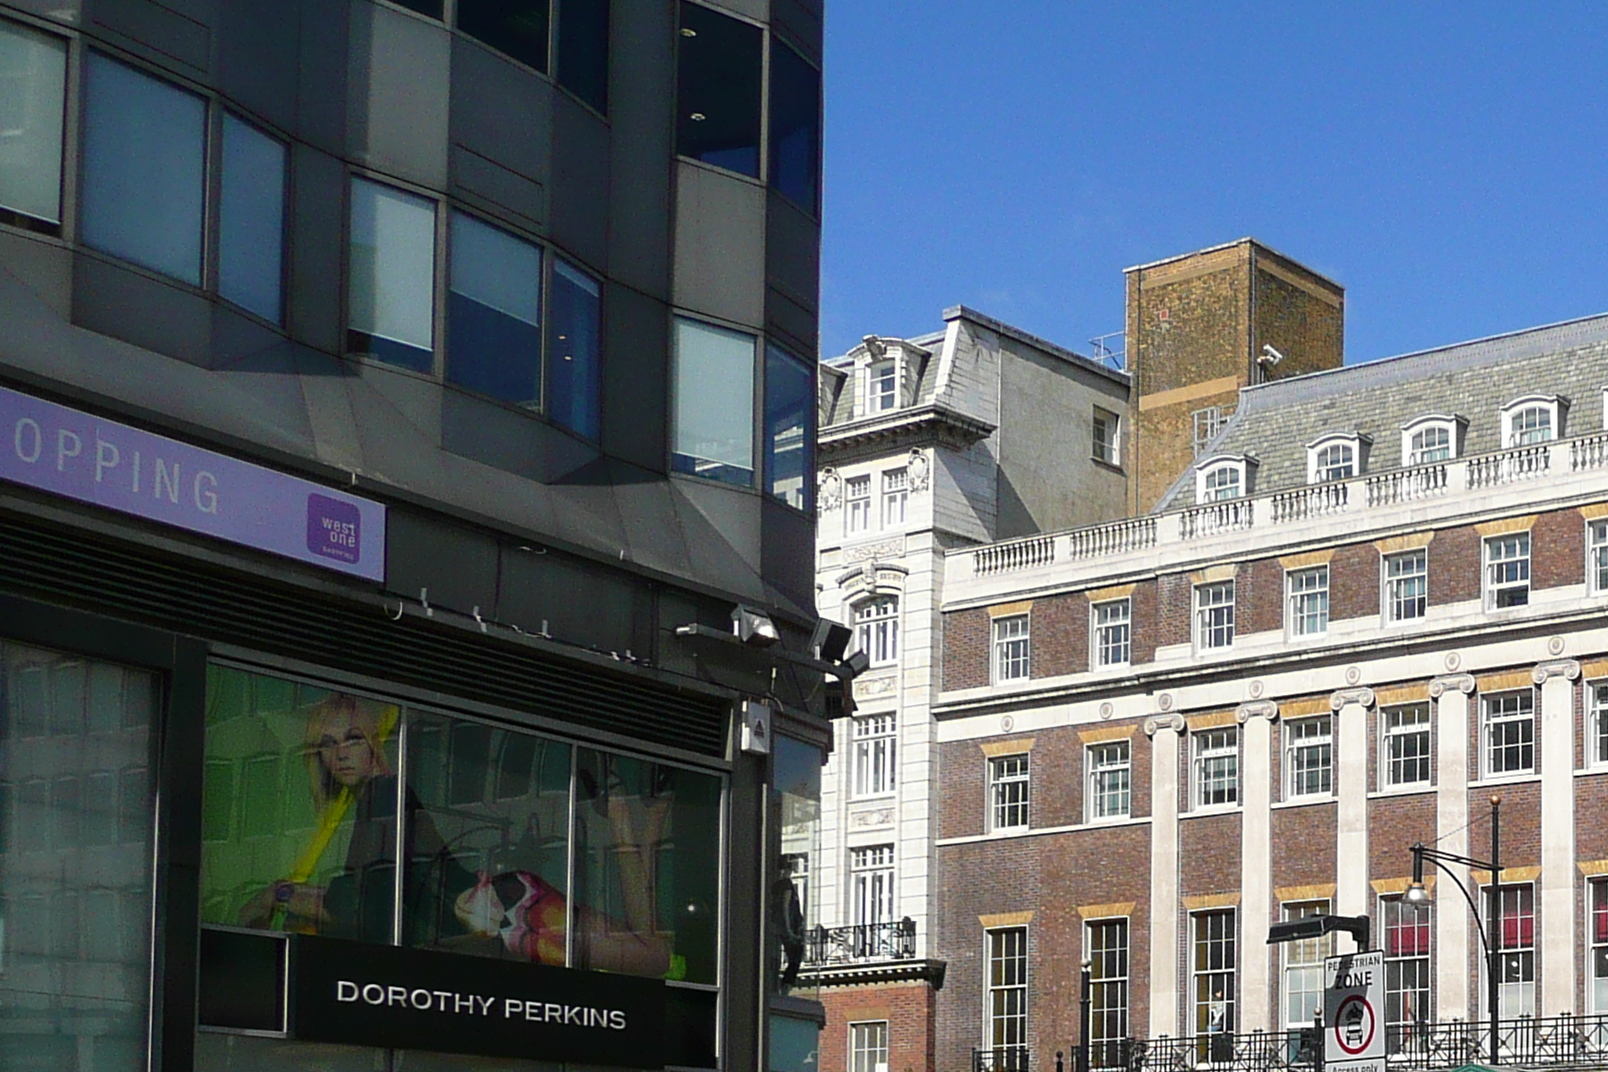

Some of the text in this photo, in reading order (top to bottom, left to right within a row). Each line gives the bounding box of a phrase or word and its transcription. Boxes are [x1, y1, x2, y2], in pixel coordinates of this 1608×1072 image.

[14, 417, 218, 515] OPPING
[321, 516, 356, 537] west
[329, 531, 356, 548] one
[1327, 954, 1381, 972] PEDESTRIAN
[1335, 970, 1373, 990] ZONE
[336, 980, 627, 1030] DOROTHY PERKINS
